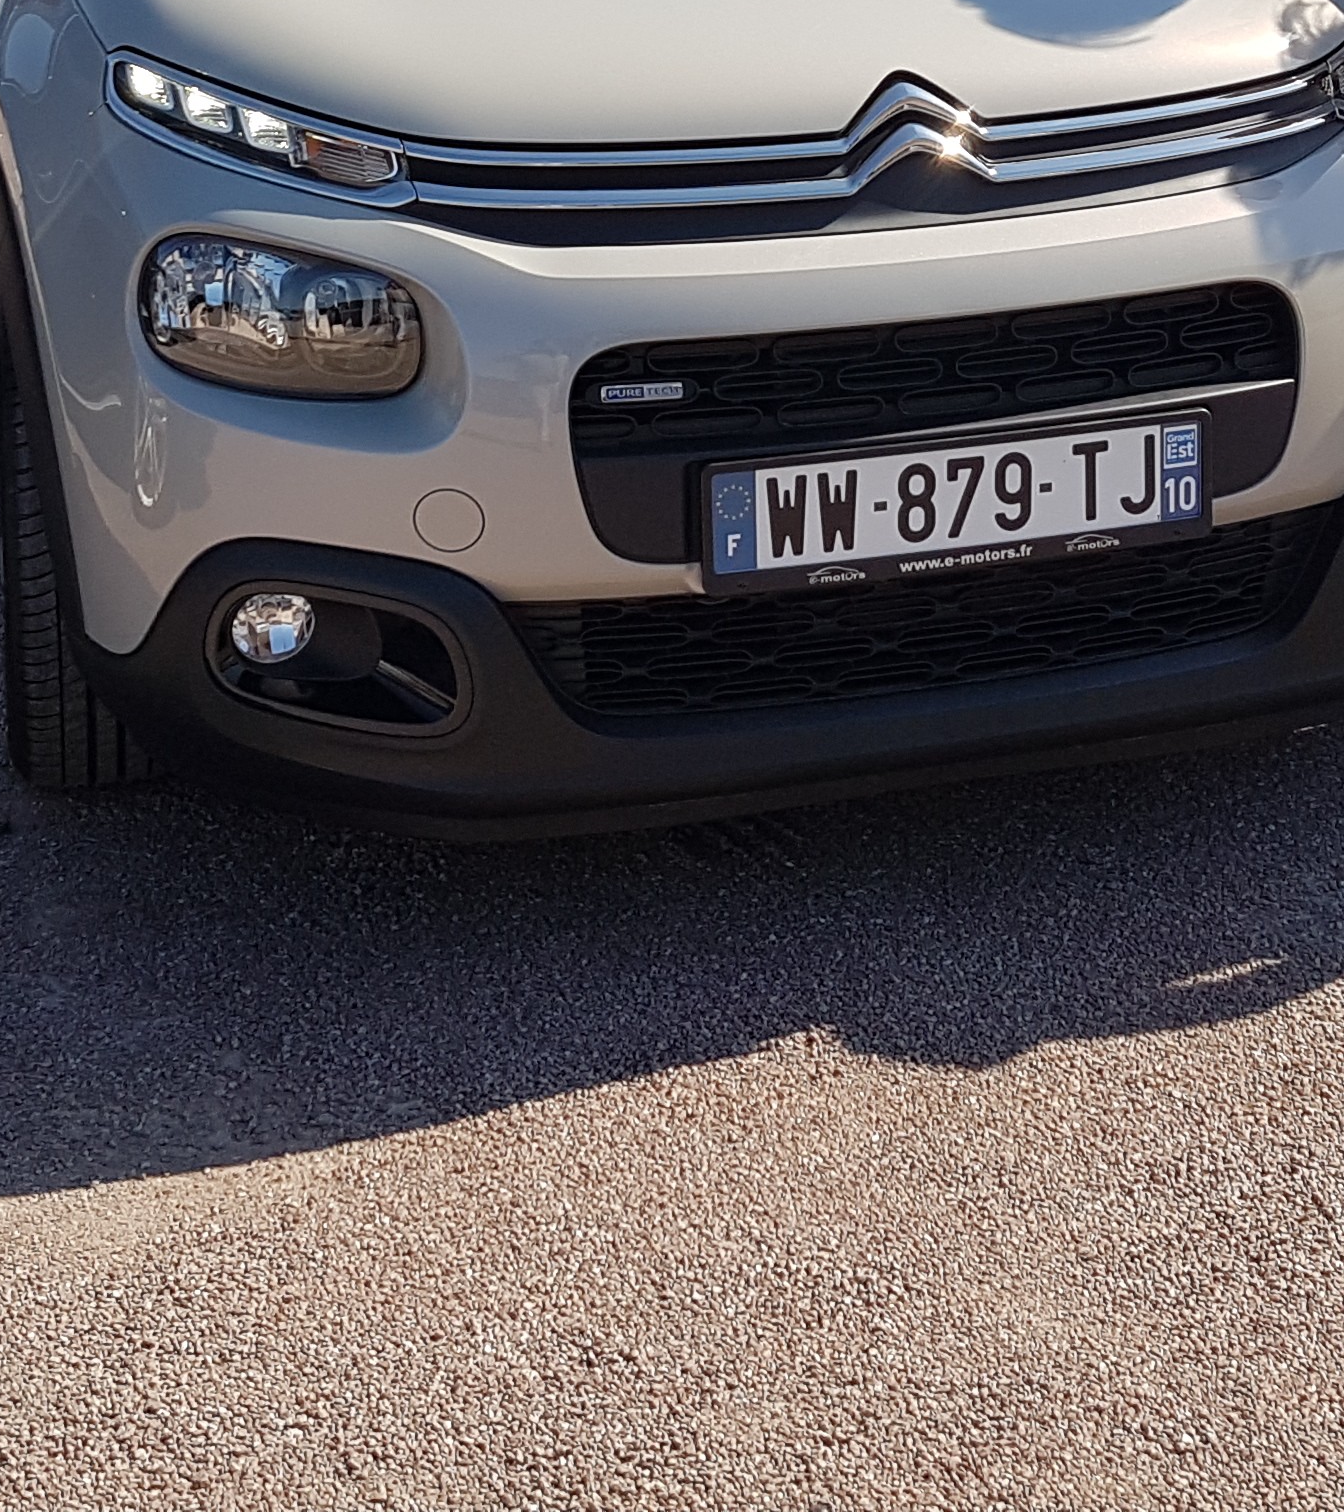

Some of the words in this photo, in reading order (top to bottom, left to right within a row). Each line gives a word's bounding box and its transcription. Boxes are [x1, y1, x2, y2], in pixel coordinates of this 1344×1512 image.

[608, 388, 643, 399] PURE
[1166, 431, 1195, 443] Grand
[1166, 441, 1194, 460] Est
[765, 433, 1156, 559] WW-879-TJ
[1164, 475, 1196, 514] 10
[726, 533, 742, 558] F
[899, 543, 1034, 574] www.e-motors.fr
